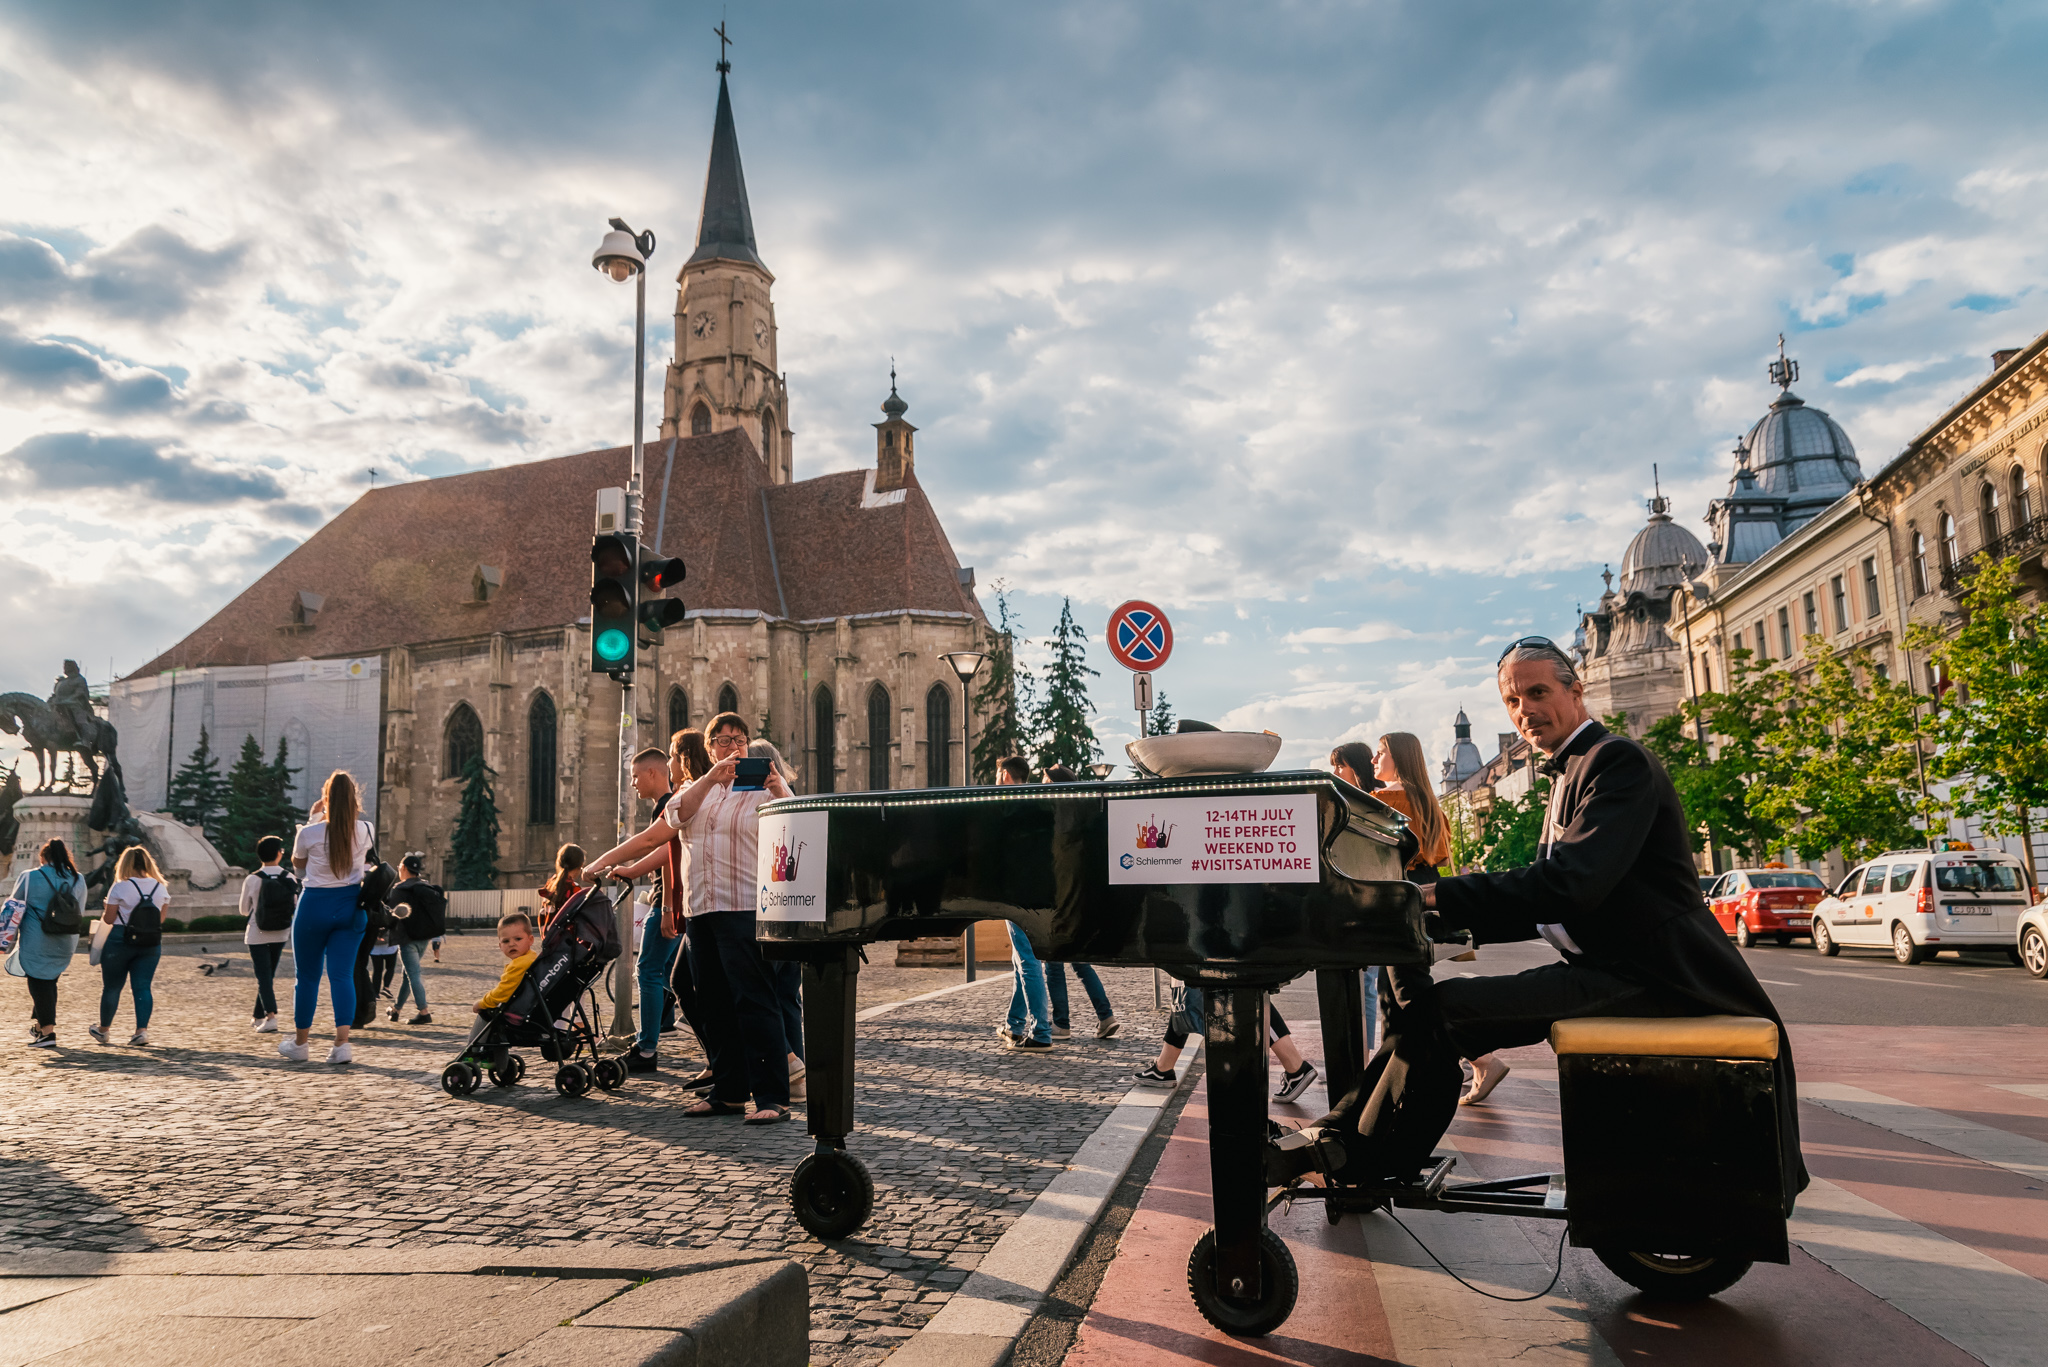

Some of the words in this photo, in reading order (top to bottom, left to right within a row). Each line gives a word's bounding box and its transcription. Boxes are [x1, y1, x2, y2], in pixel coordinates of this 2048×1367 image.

[1206, 810, 1257, 822] 12-14TH
[1261, 809, 1294, 821] JULY
[1205, 826, 1231, 838] THE
[1235, 825, 1296, 838] PERFECT
[1205, 842, 1274, 855] WEEKEND
[1278, 841, 1297, 853] TO
[1136, 856, 1183, 866] Schlemmer
[1191, 858, 1312, 871] #VISITSATUMARE
[769, 891, 816, 906] Schlemmer
